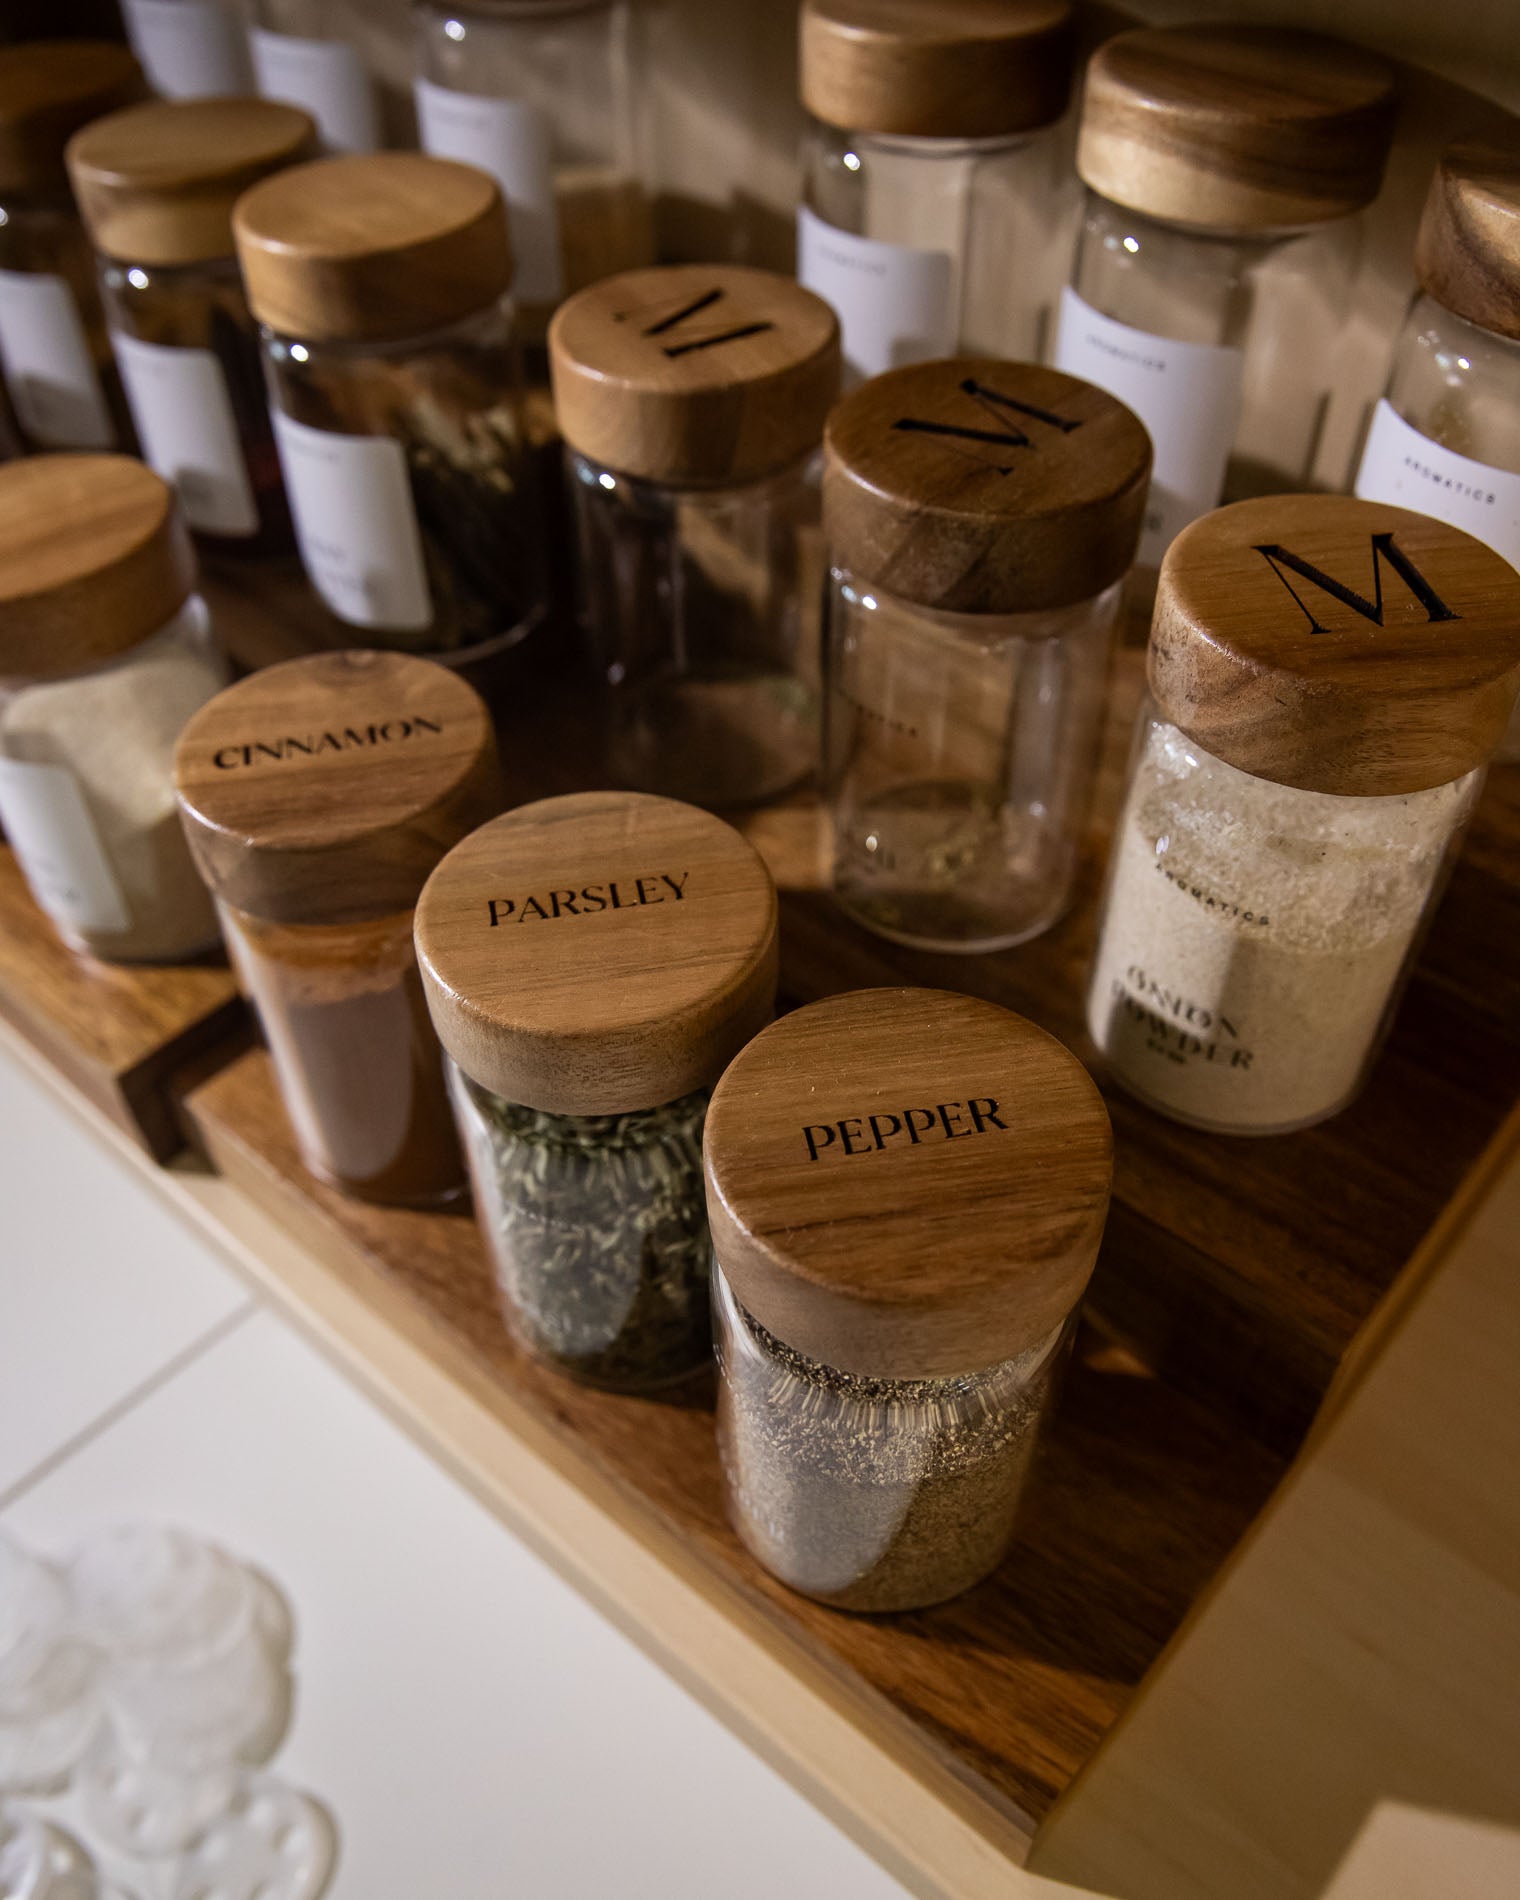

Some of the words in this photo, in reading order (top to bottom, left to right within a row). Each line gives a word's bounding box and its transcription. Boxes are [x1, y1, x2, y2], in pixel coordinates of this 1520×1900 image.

[1251, 532, 1463, 635] M
[212, 714, 442, 770] CINNAMON
[487, 871, 689, 927] PARSLEY
[1155, 862, 1270, 926] AROMATICS
[801, 1097, 1009, 1161] PEPPER
